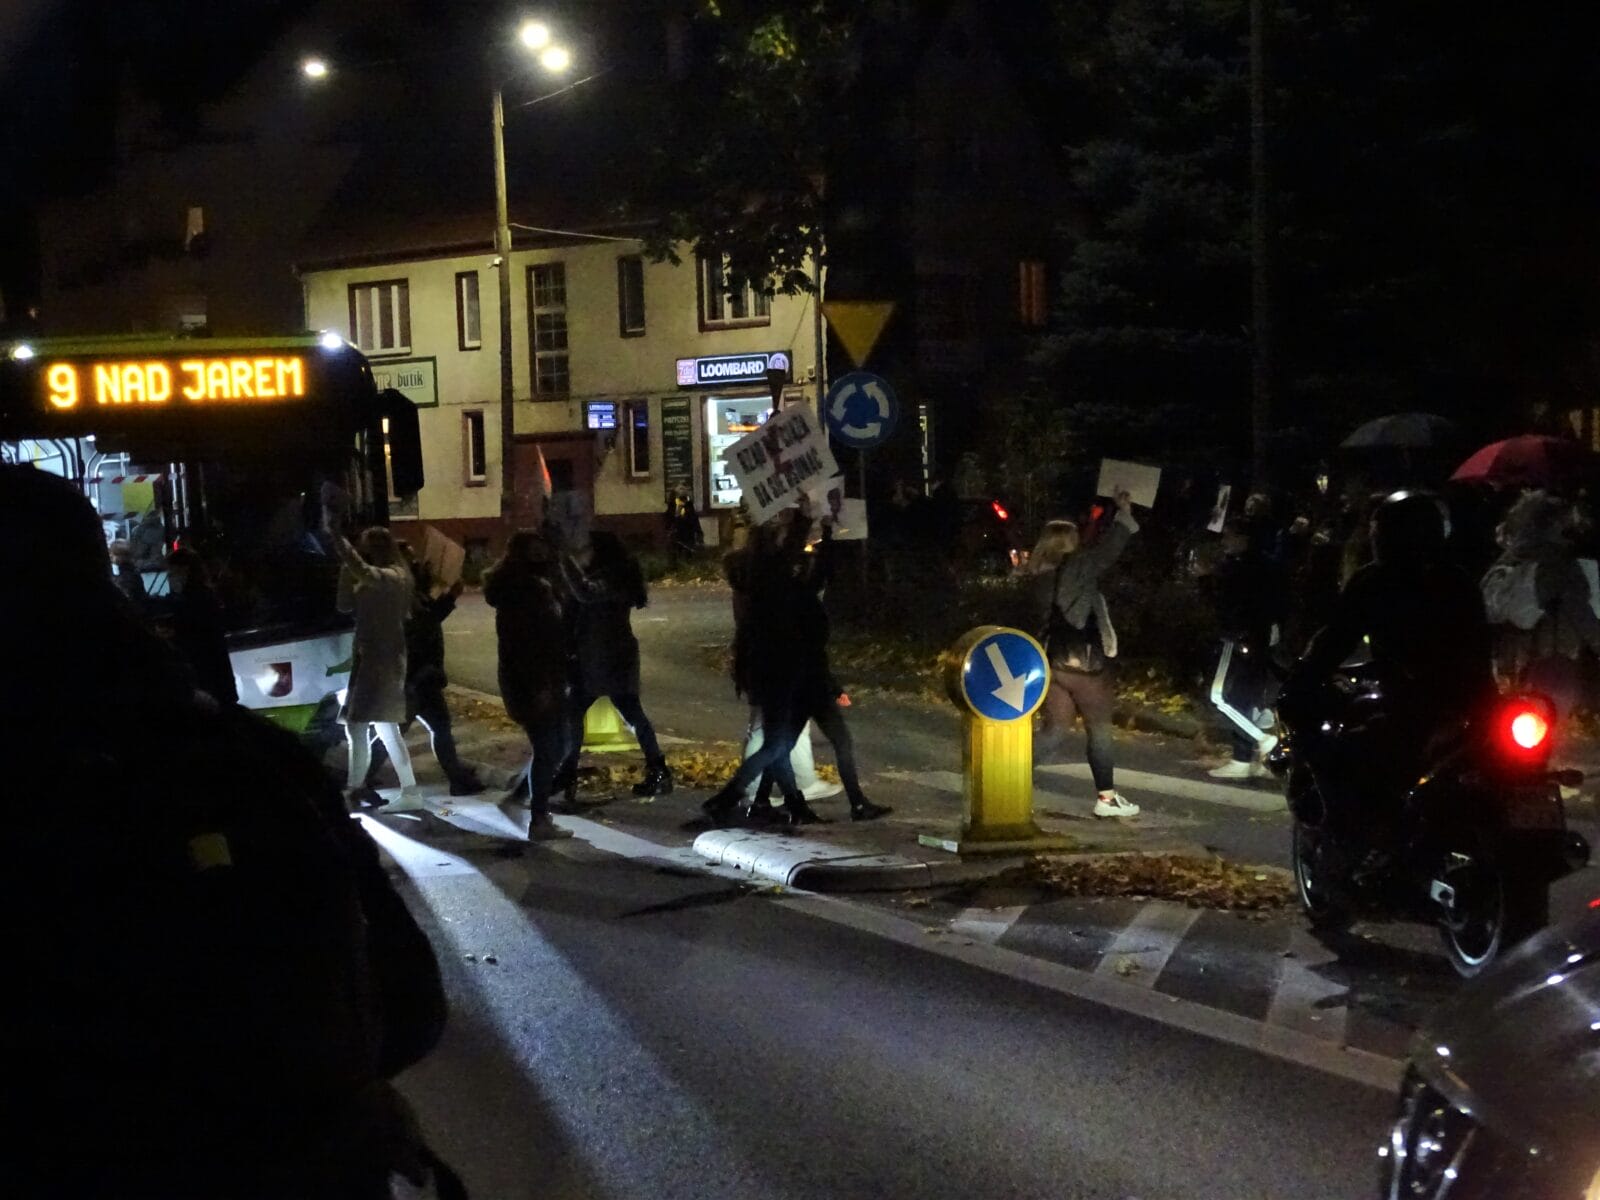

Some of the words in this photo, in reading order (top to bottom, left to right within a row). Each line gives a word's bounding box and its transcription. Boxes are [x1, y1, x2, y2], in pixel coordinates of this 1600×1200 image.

[701, 361, 765, 378] LOOMBARD
[48, 363, 77, 408] 9
[95, 362, 170, 404] NAD
[181, 357, 303, 400] JAREM
[397, 370, 423, 388] butik
